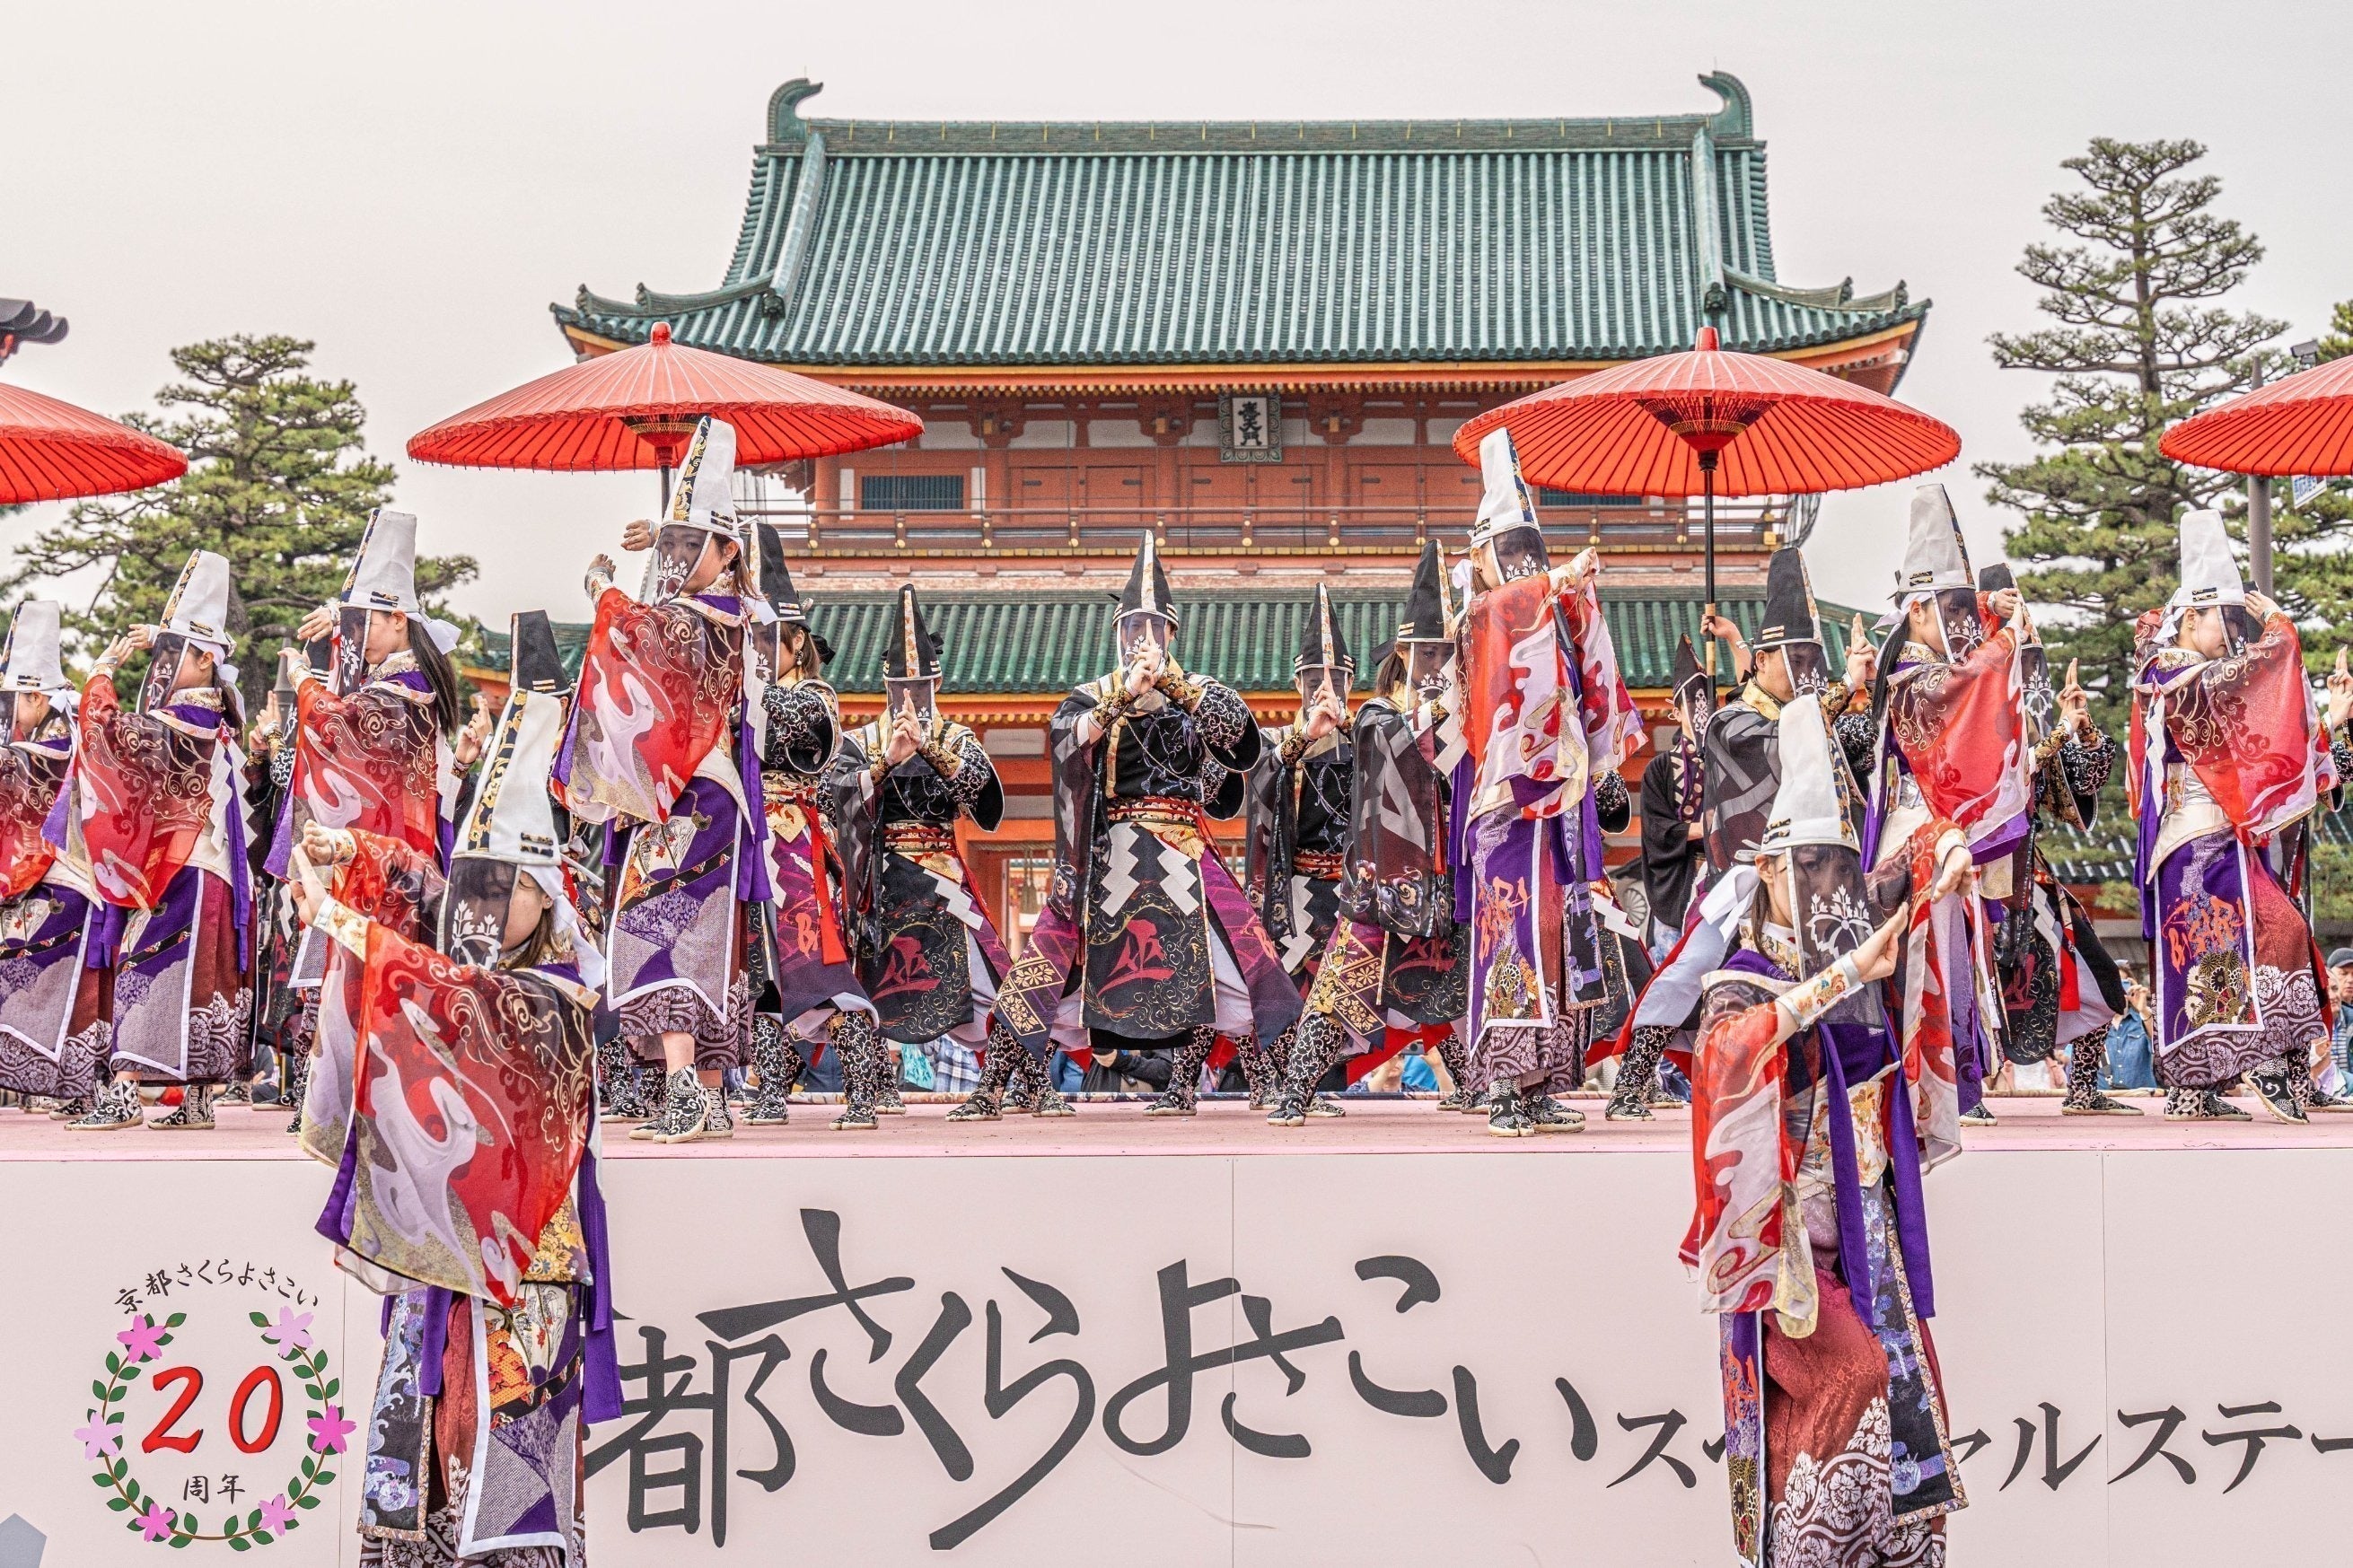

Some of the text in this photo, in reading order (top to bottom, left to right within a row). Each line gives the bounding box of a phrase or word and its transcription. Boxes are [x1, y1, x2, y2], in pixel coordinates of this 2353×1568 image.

[114, 1258, 319, 1315] 京都さくらよさこい
[141, 1365, 285, 1454] 20
[580, 1208, 1598, 1551] 都さくらよさこい
[182, 1474, 246, 1504] 周年
